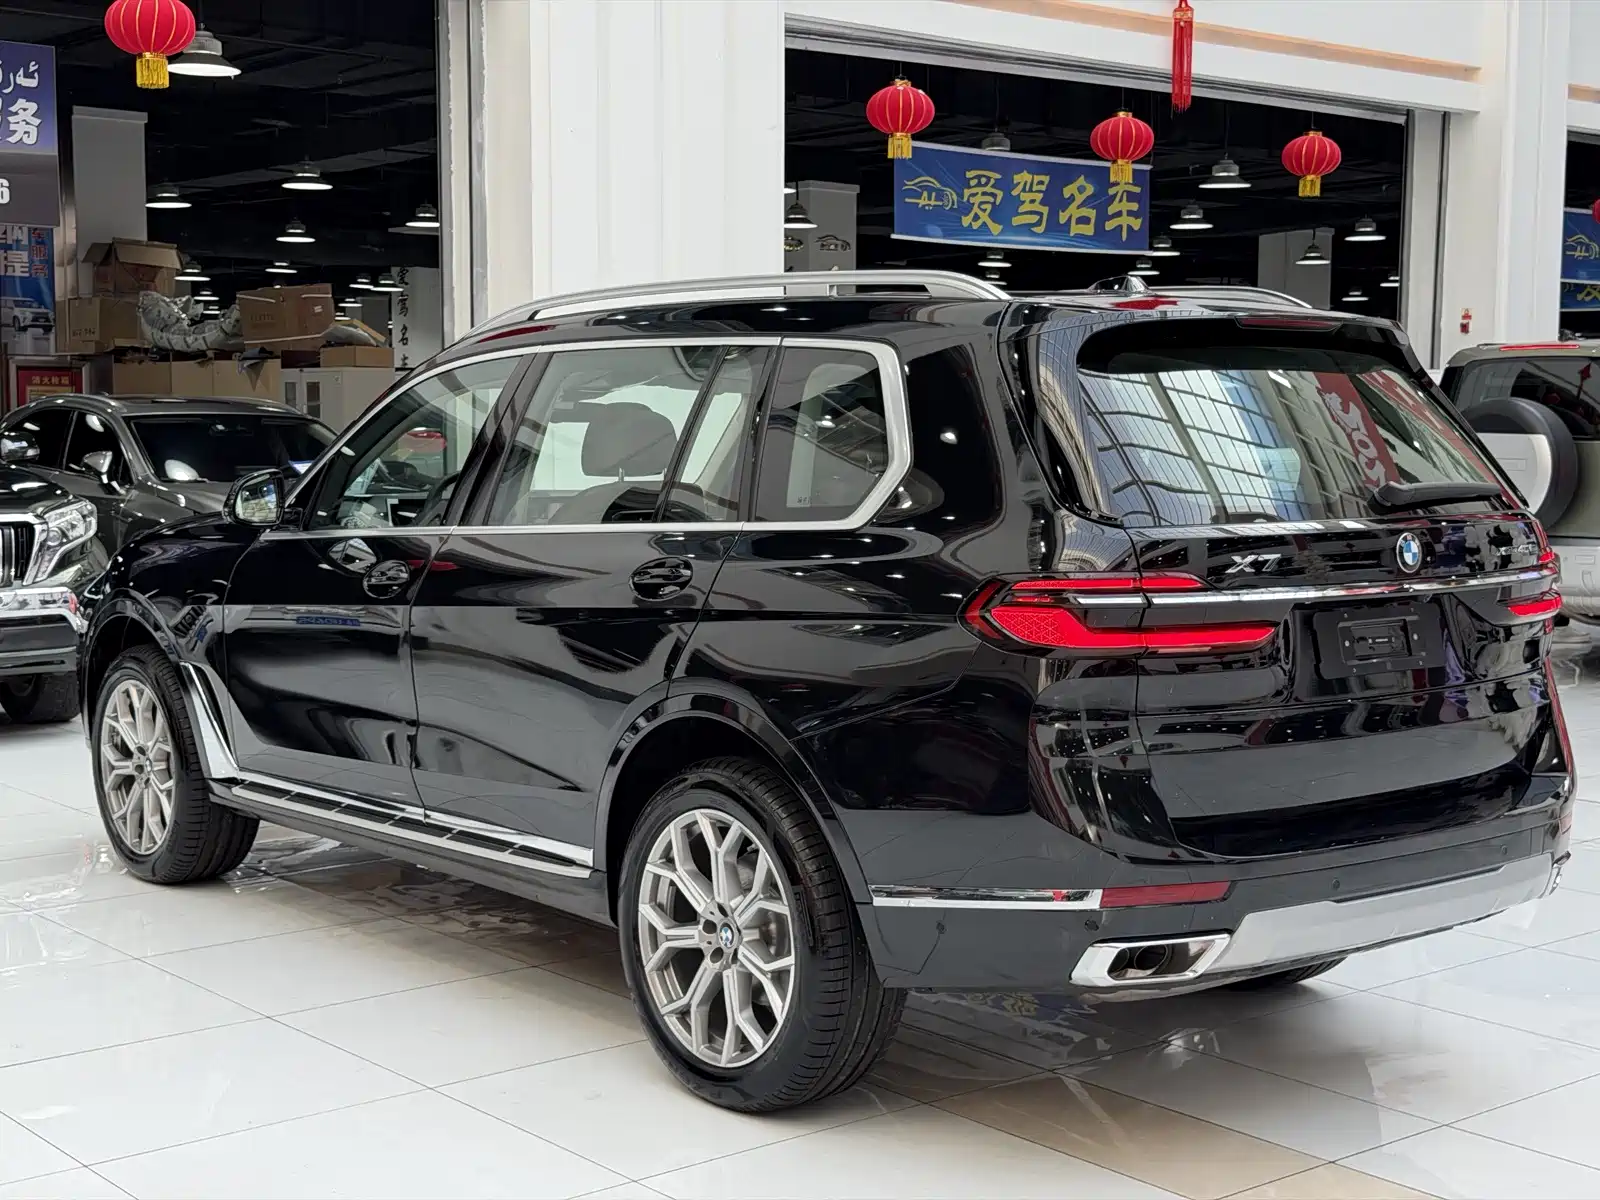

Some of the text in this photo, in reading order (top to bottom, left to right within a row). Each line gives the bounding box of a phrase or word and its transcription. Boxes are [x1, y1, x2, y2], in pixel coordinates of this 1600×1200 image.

[0, 97, 42, 145] 务
[961, 169, 1143, 242] 爱驾名车
[1224, 553, 1282, 574] X7
